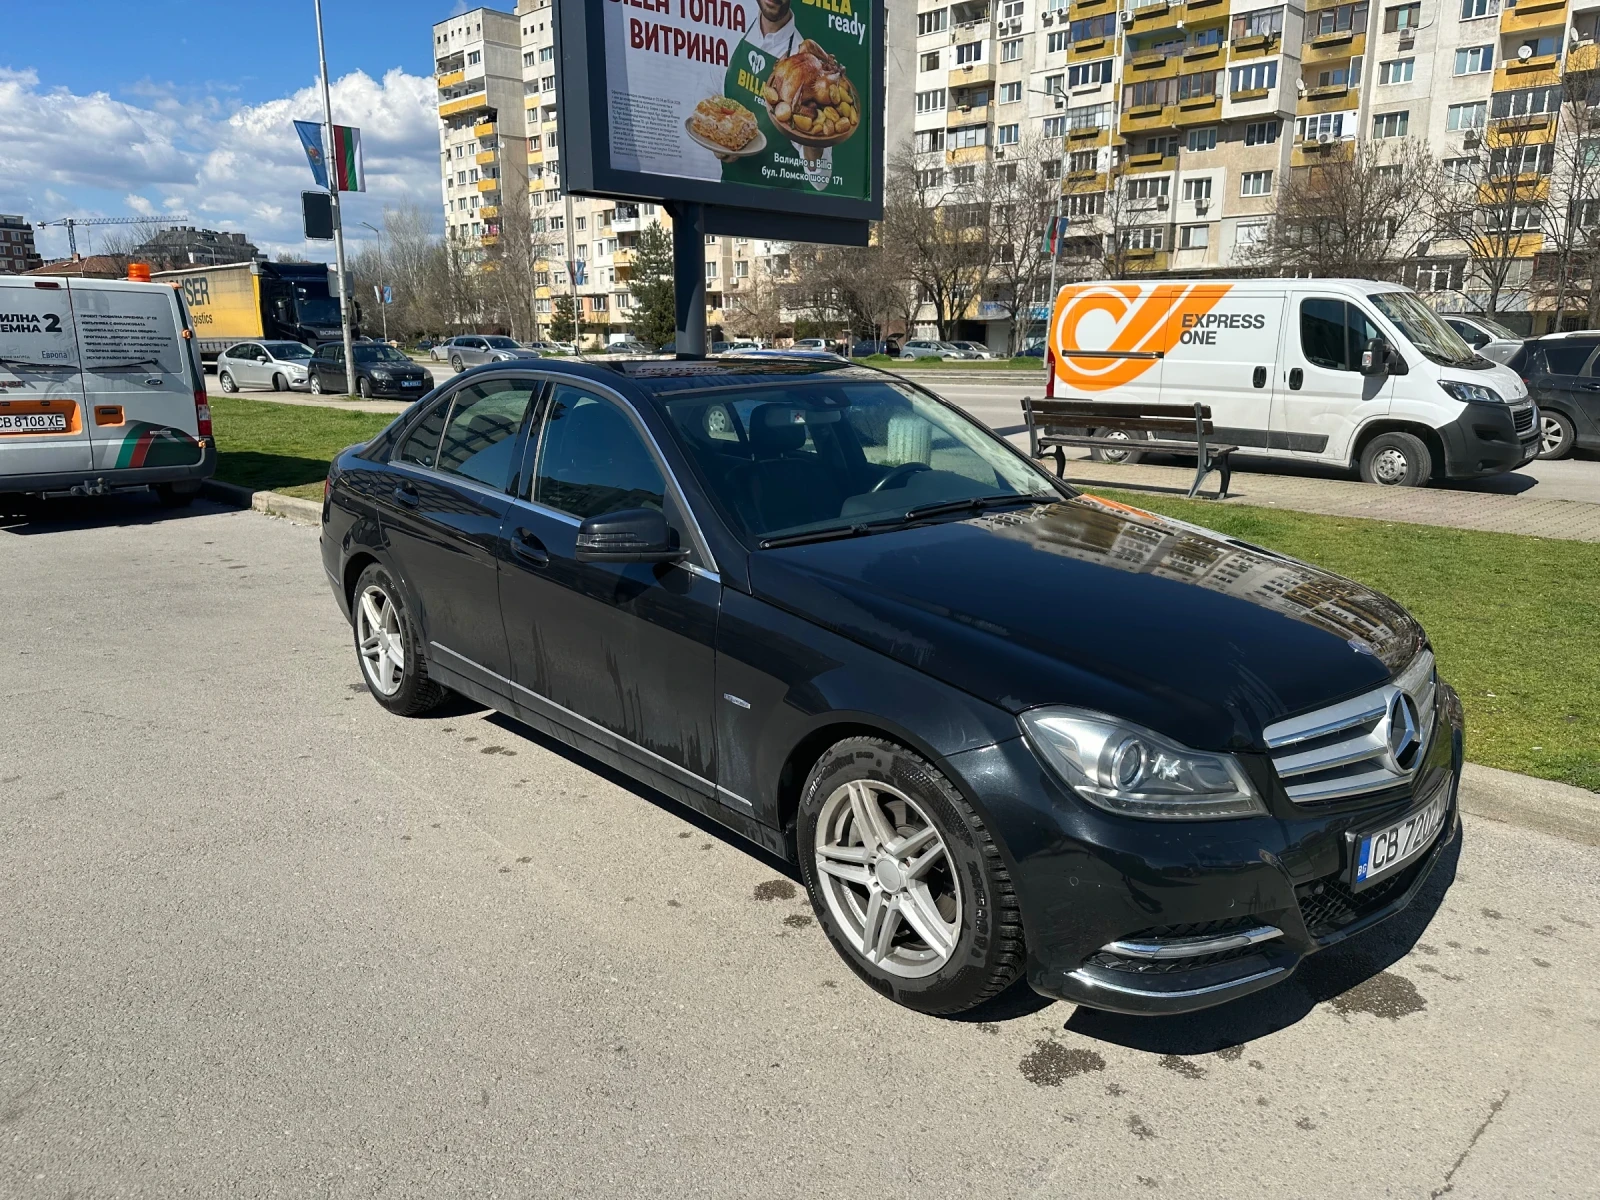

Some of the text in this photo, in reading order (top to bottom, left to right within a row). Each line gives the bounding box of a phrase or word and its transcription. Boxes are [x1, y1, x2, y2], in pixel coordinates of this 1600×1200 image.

[828, 12, 866, 45] ready
[630, 17, 729, 67] ВИТРИНА
[774, 152, 832, 170] Валидно в Billa
[761, 166, 843, 185] бул. Ломско шосе 171
[42, 313, 63, 333] 2
[1181, 313, 1266, 329] EXPRESS
[1180, 330, 1218, 345] ONE
[41, 350, 68, 359] Европа
[14, 415, 46, 428] 8108
[46, 415, 64, 427] XE
[1372, 827, 1399, 869] CB
[1357, 862, 1368, 876] BG
